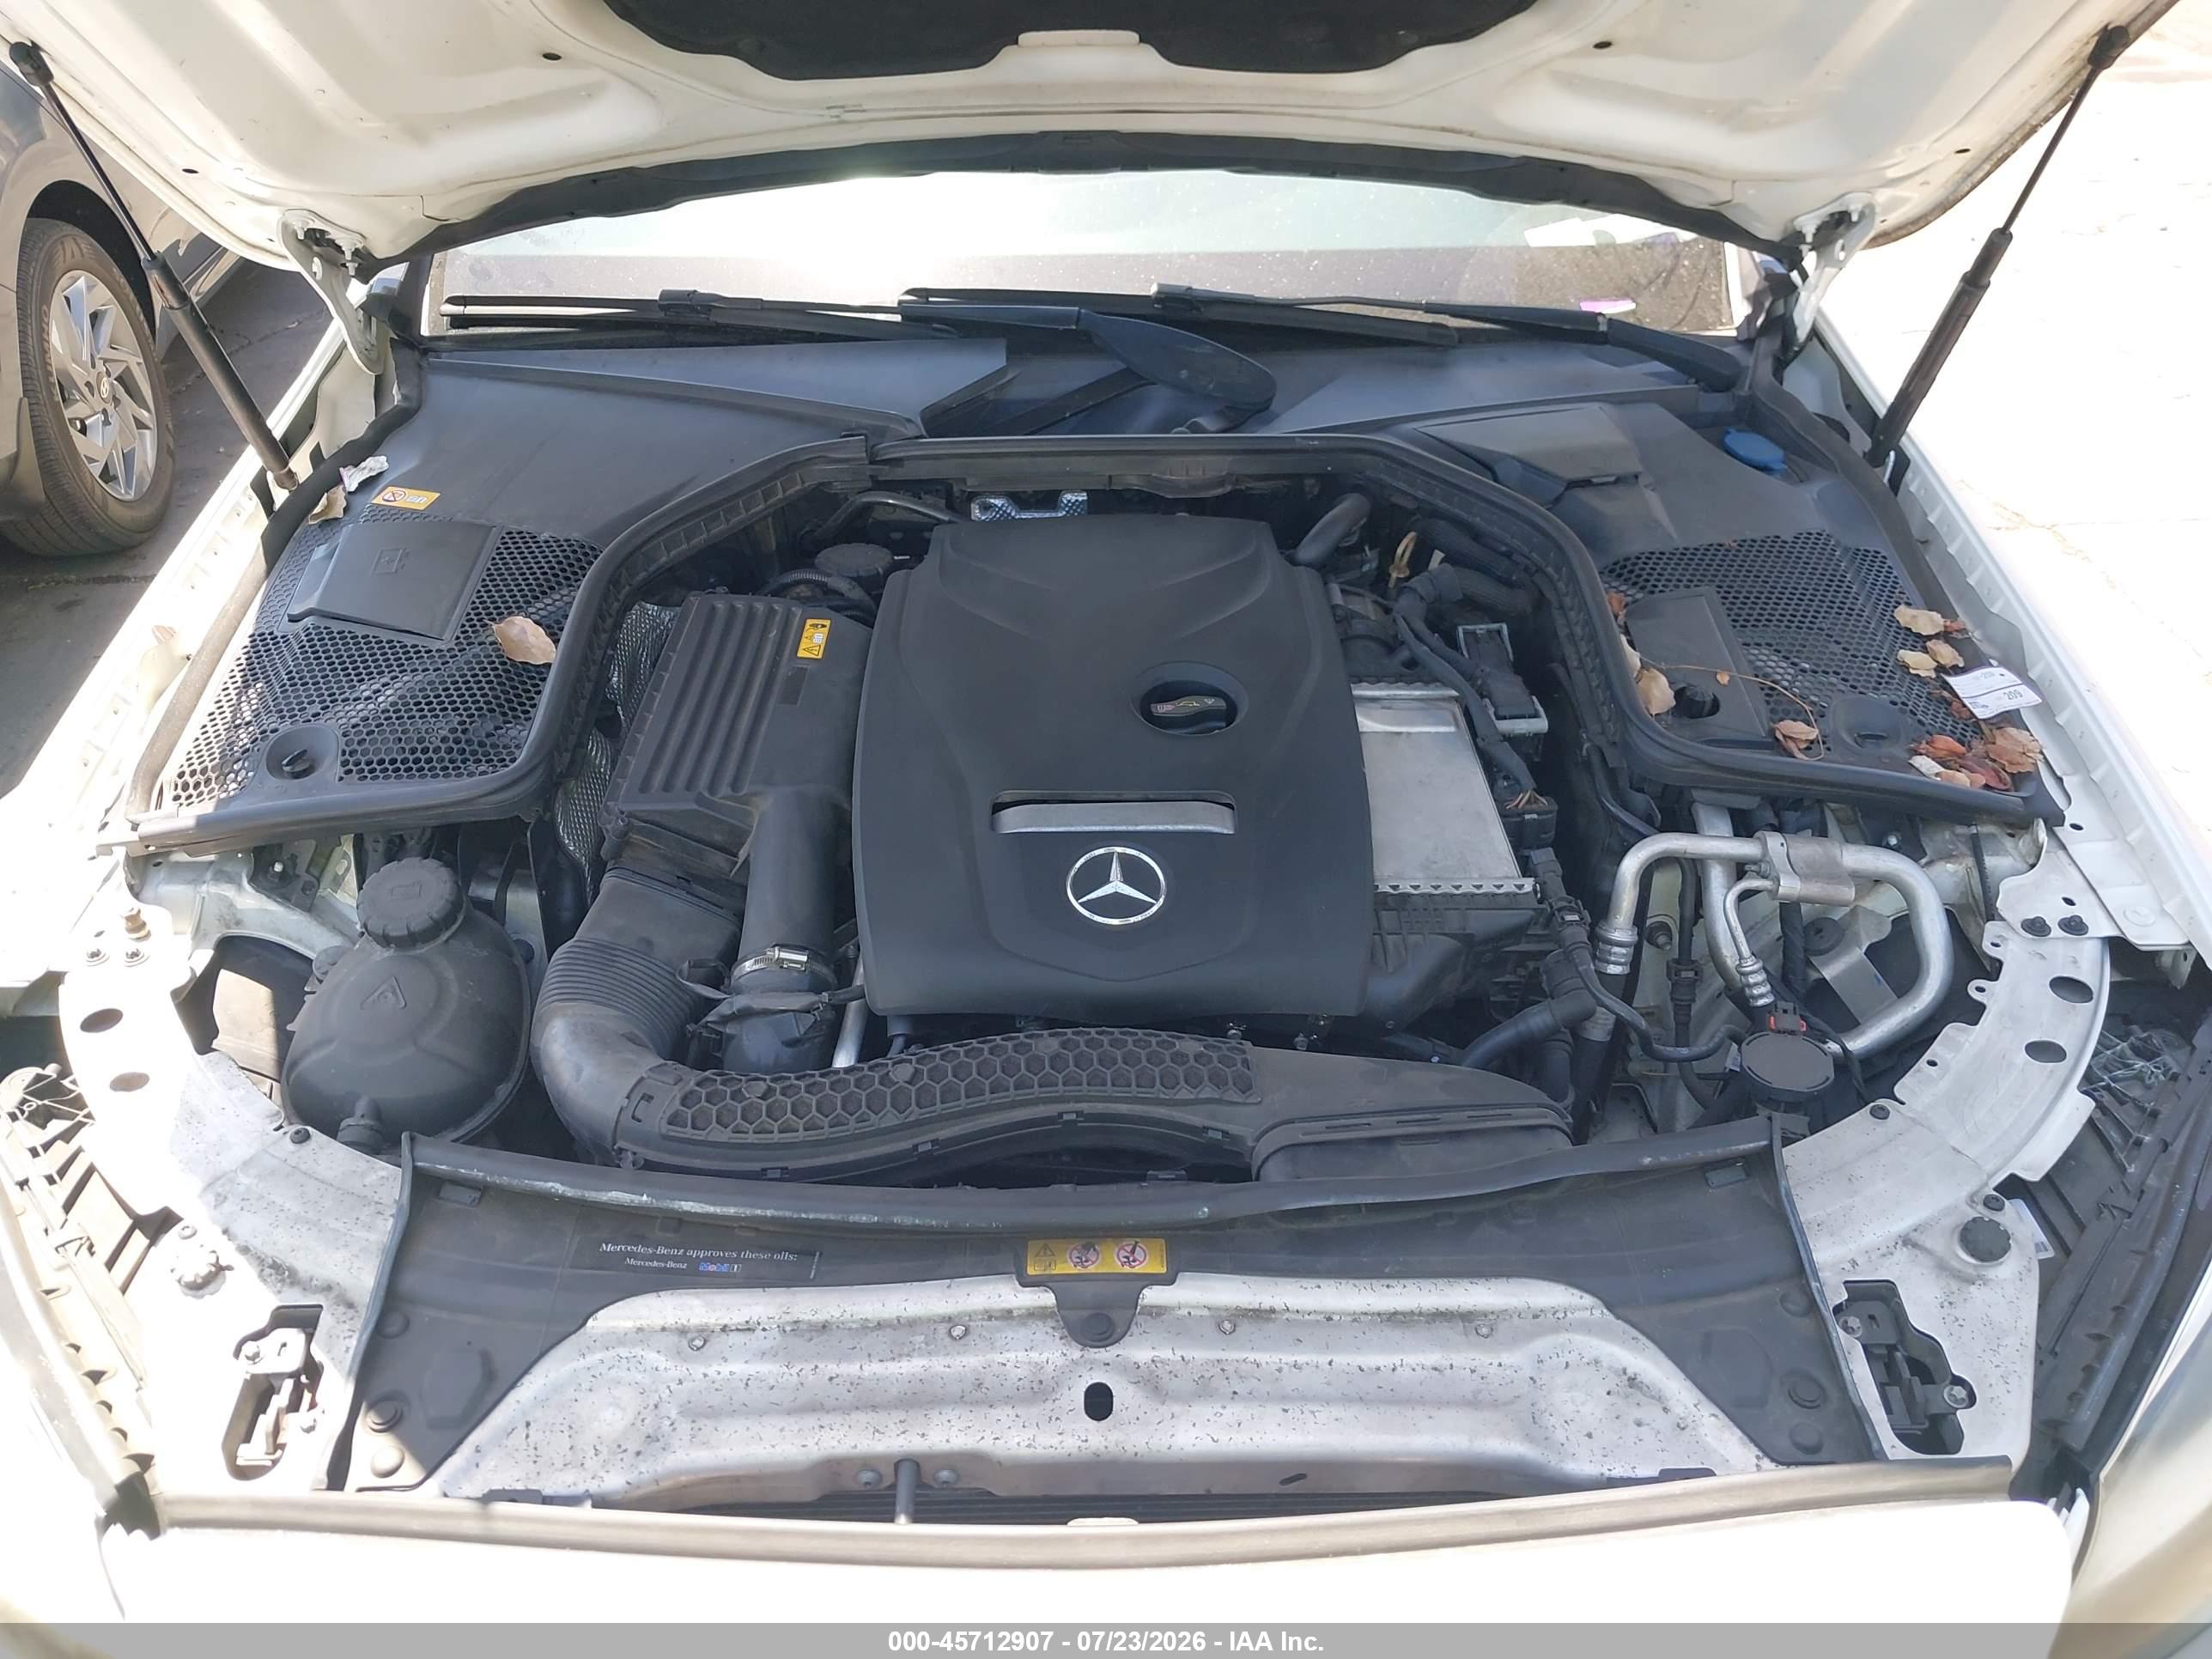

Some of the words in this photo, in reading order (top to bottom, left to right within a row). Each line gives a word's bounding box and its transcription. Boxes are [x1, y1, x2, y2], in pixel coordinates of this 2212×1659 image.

[599, 1243, 685, 1255] Mercedes-Benz
[687, 1249, 738, 1258] approves
[740, 1249, 771, 1260] these
[773, 1251, 798, 1261] oils:
[624, 1256, 688, 1269] Mercedes-Benz
